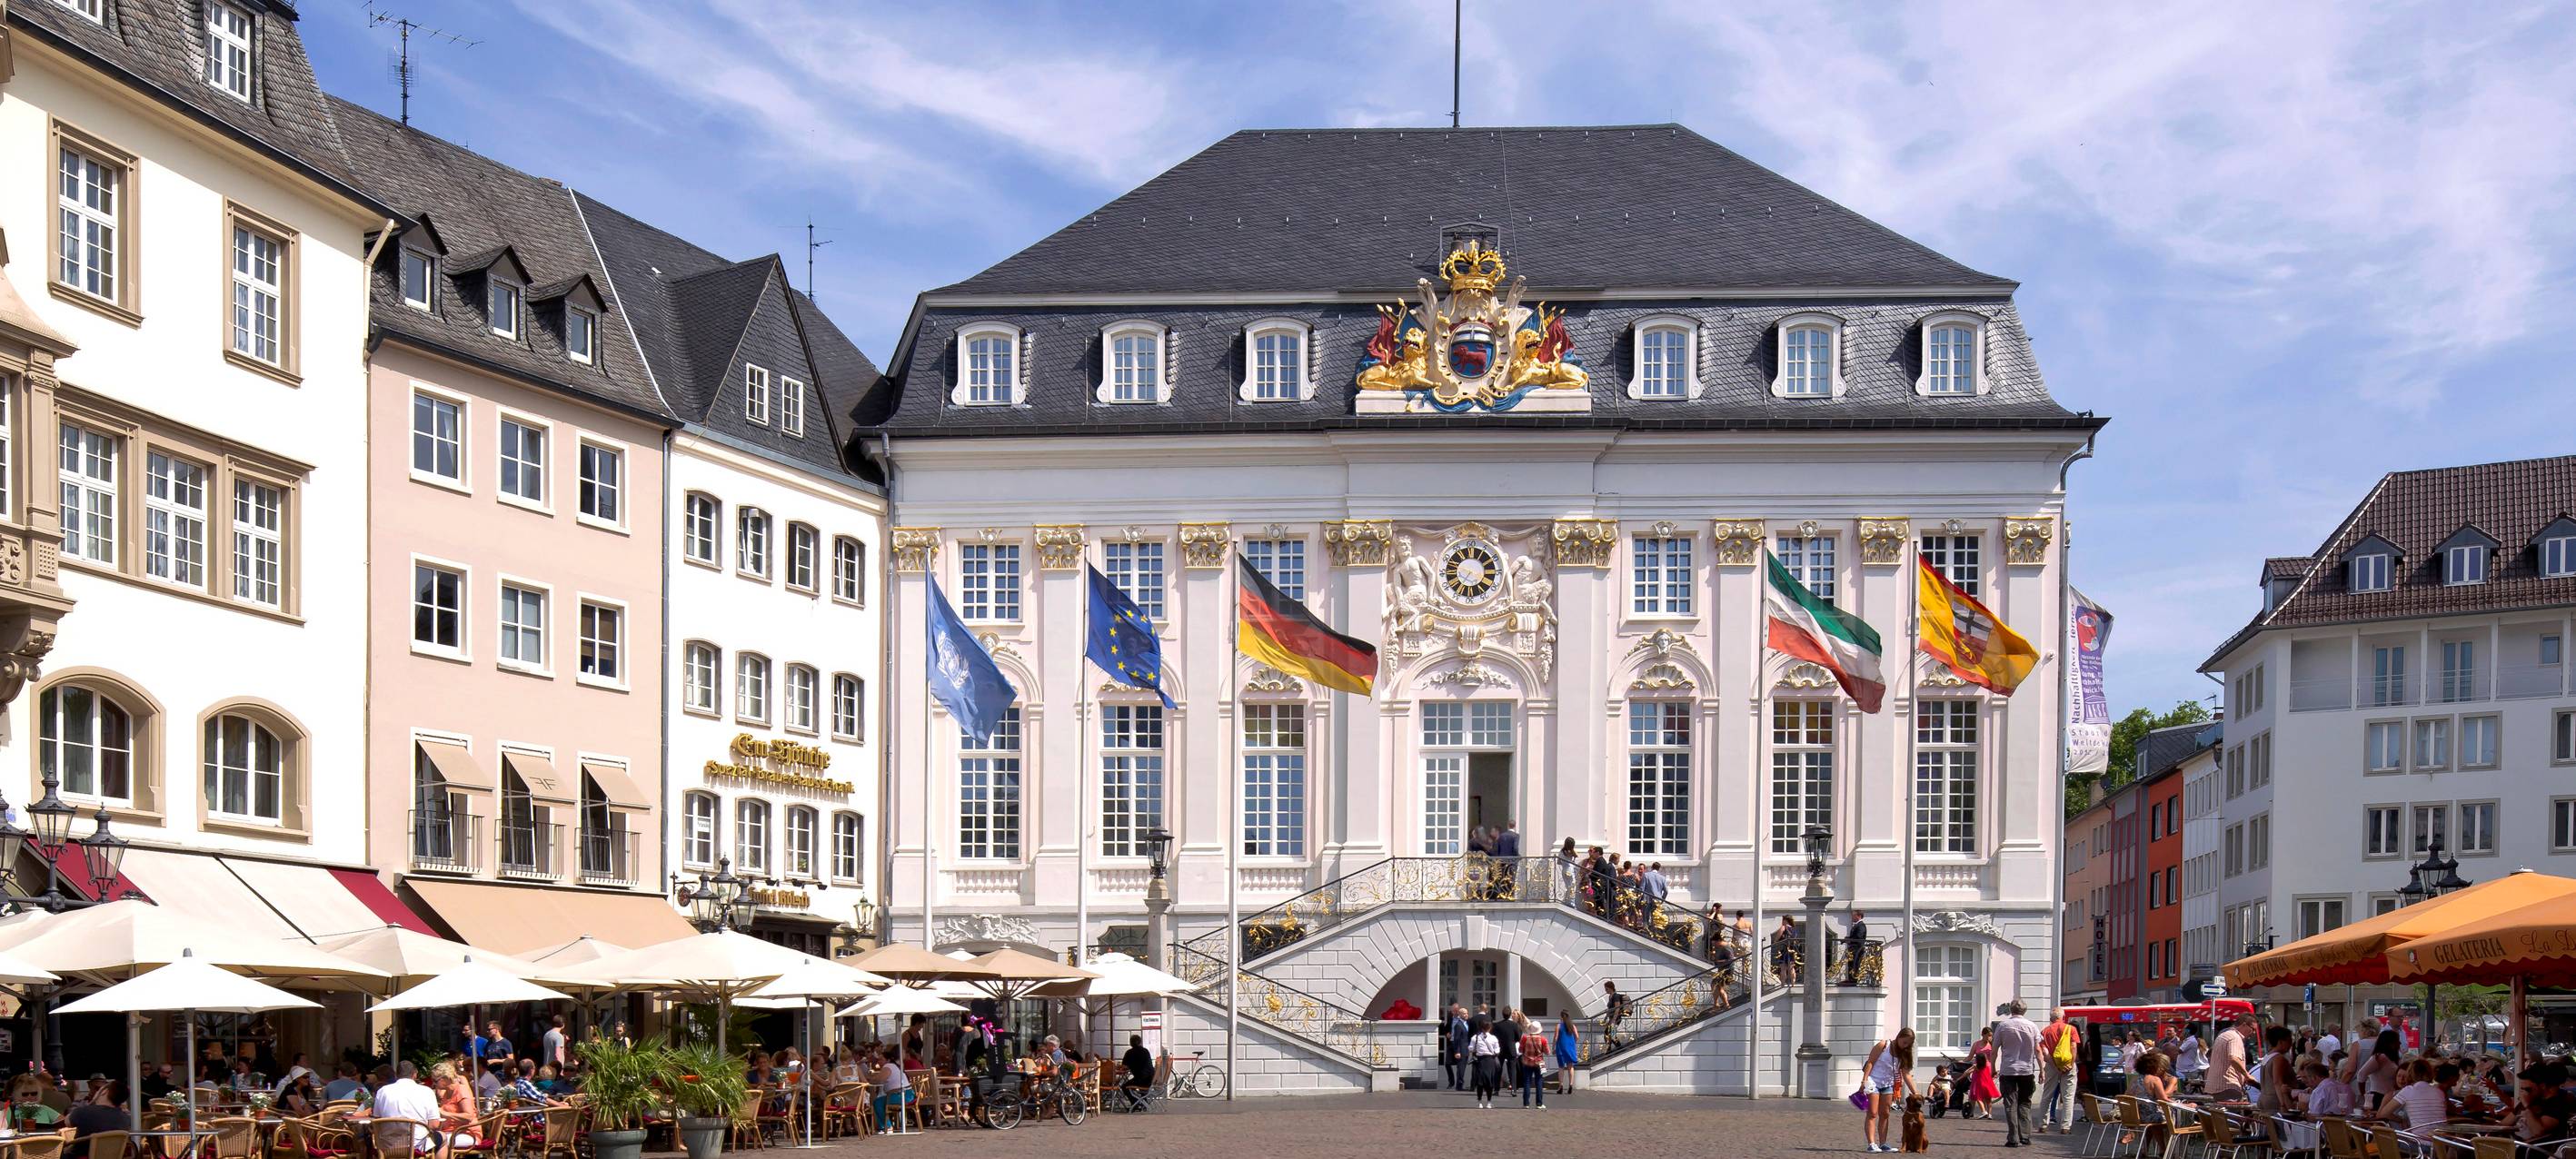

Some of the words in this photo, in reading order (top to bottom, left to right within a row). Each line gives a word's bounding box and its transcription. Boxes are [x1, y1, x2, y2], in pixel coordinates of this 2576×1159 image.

[1443, 554, 1450, 563] 50
[1492, 553, 1498, 561] 10
[2095, 918, 2104, 975] HOTEL
[2433, 936, 2508, 965] GELATERIA
[2520, 929, 2552, 954] La
[2247, 956, 2290, 978] GELATERIA
